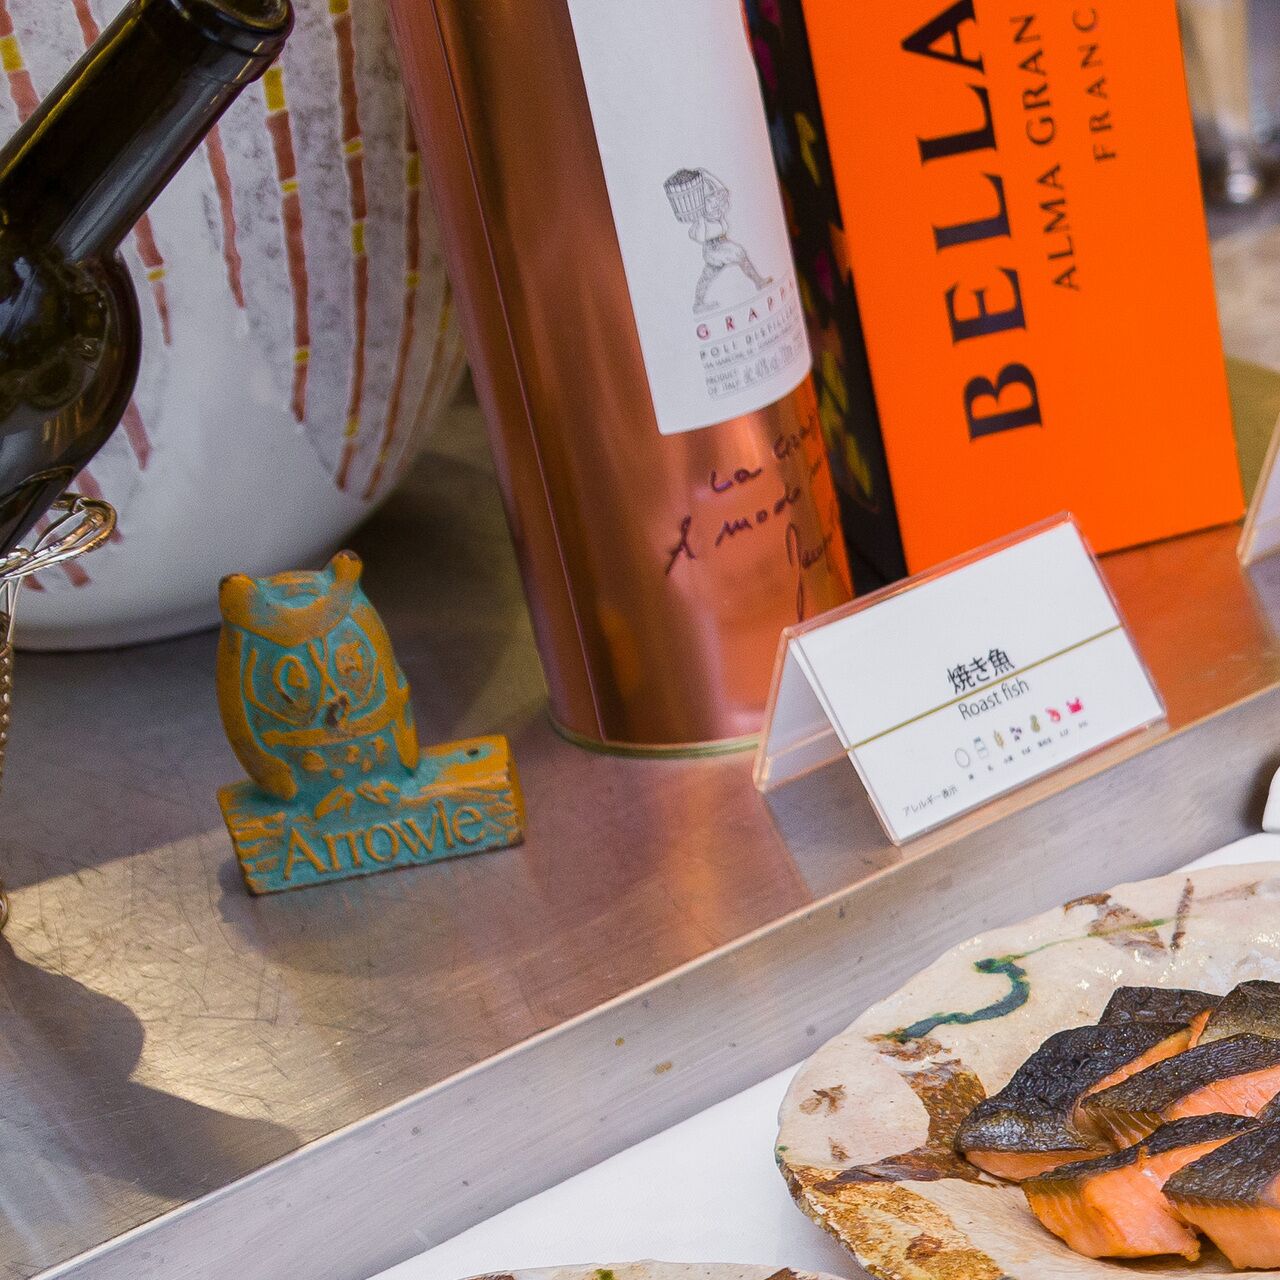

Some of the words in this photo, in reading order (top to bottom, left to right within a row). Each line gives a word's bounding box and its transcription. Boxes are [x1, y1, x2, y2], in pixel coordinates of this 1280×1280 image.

[1009, 13, 1056, 146] GRAN
[1071, 7, 1117, 163] FRANC
[901, 0, 1043, 443] BELLA
[1036, 162, 1080, 292] ALMA
[947, 648, 1016, 695] 焼き魚
[957, 690, 1002, 720] Roast
[1000, 676, 1030, 702] fish
